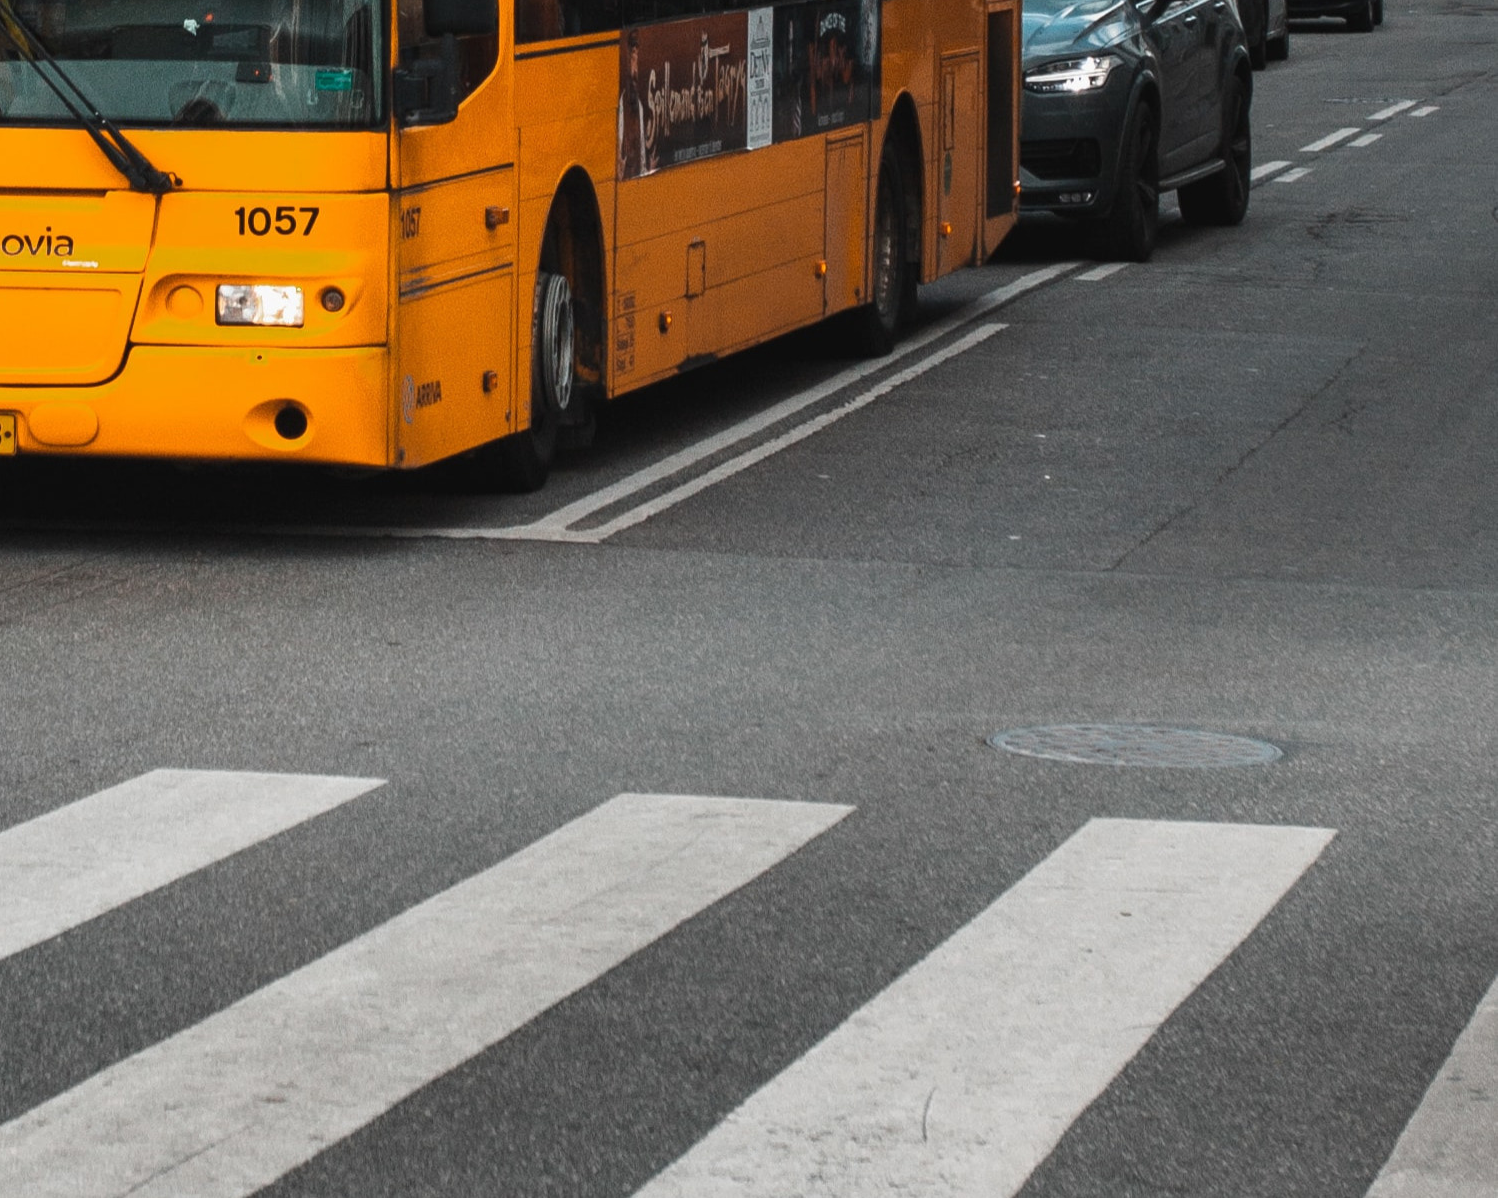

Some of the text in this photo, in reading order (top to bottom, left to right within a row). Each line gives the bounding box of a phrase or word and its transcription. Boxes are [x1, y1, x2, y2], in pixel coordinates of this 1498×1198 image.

[235, 206, 319, 236] 1057
[401, 207, 421, 239] 1057
[416, 380, 442, 409] ARRIVA
